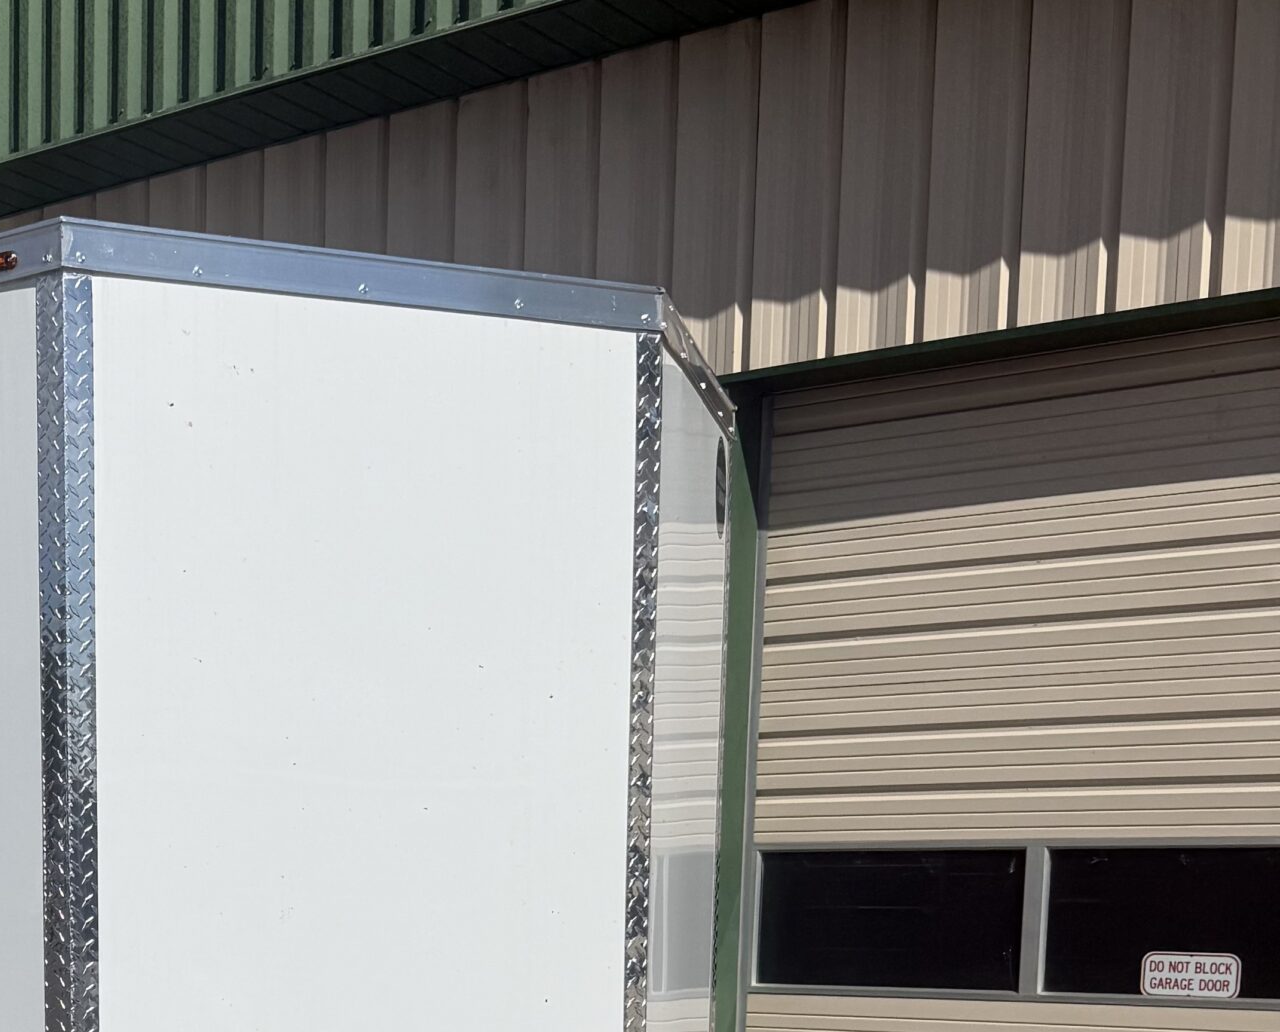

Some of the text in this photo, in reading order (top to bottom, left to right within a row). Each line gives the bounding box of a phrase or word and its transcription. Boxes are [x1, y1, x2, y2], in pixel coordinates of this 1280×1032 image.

[1149, 960, 1233, 975] DO NOT BLOCK
[1149, 977, 1230, 992] GARAGE DOOR
